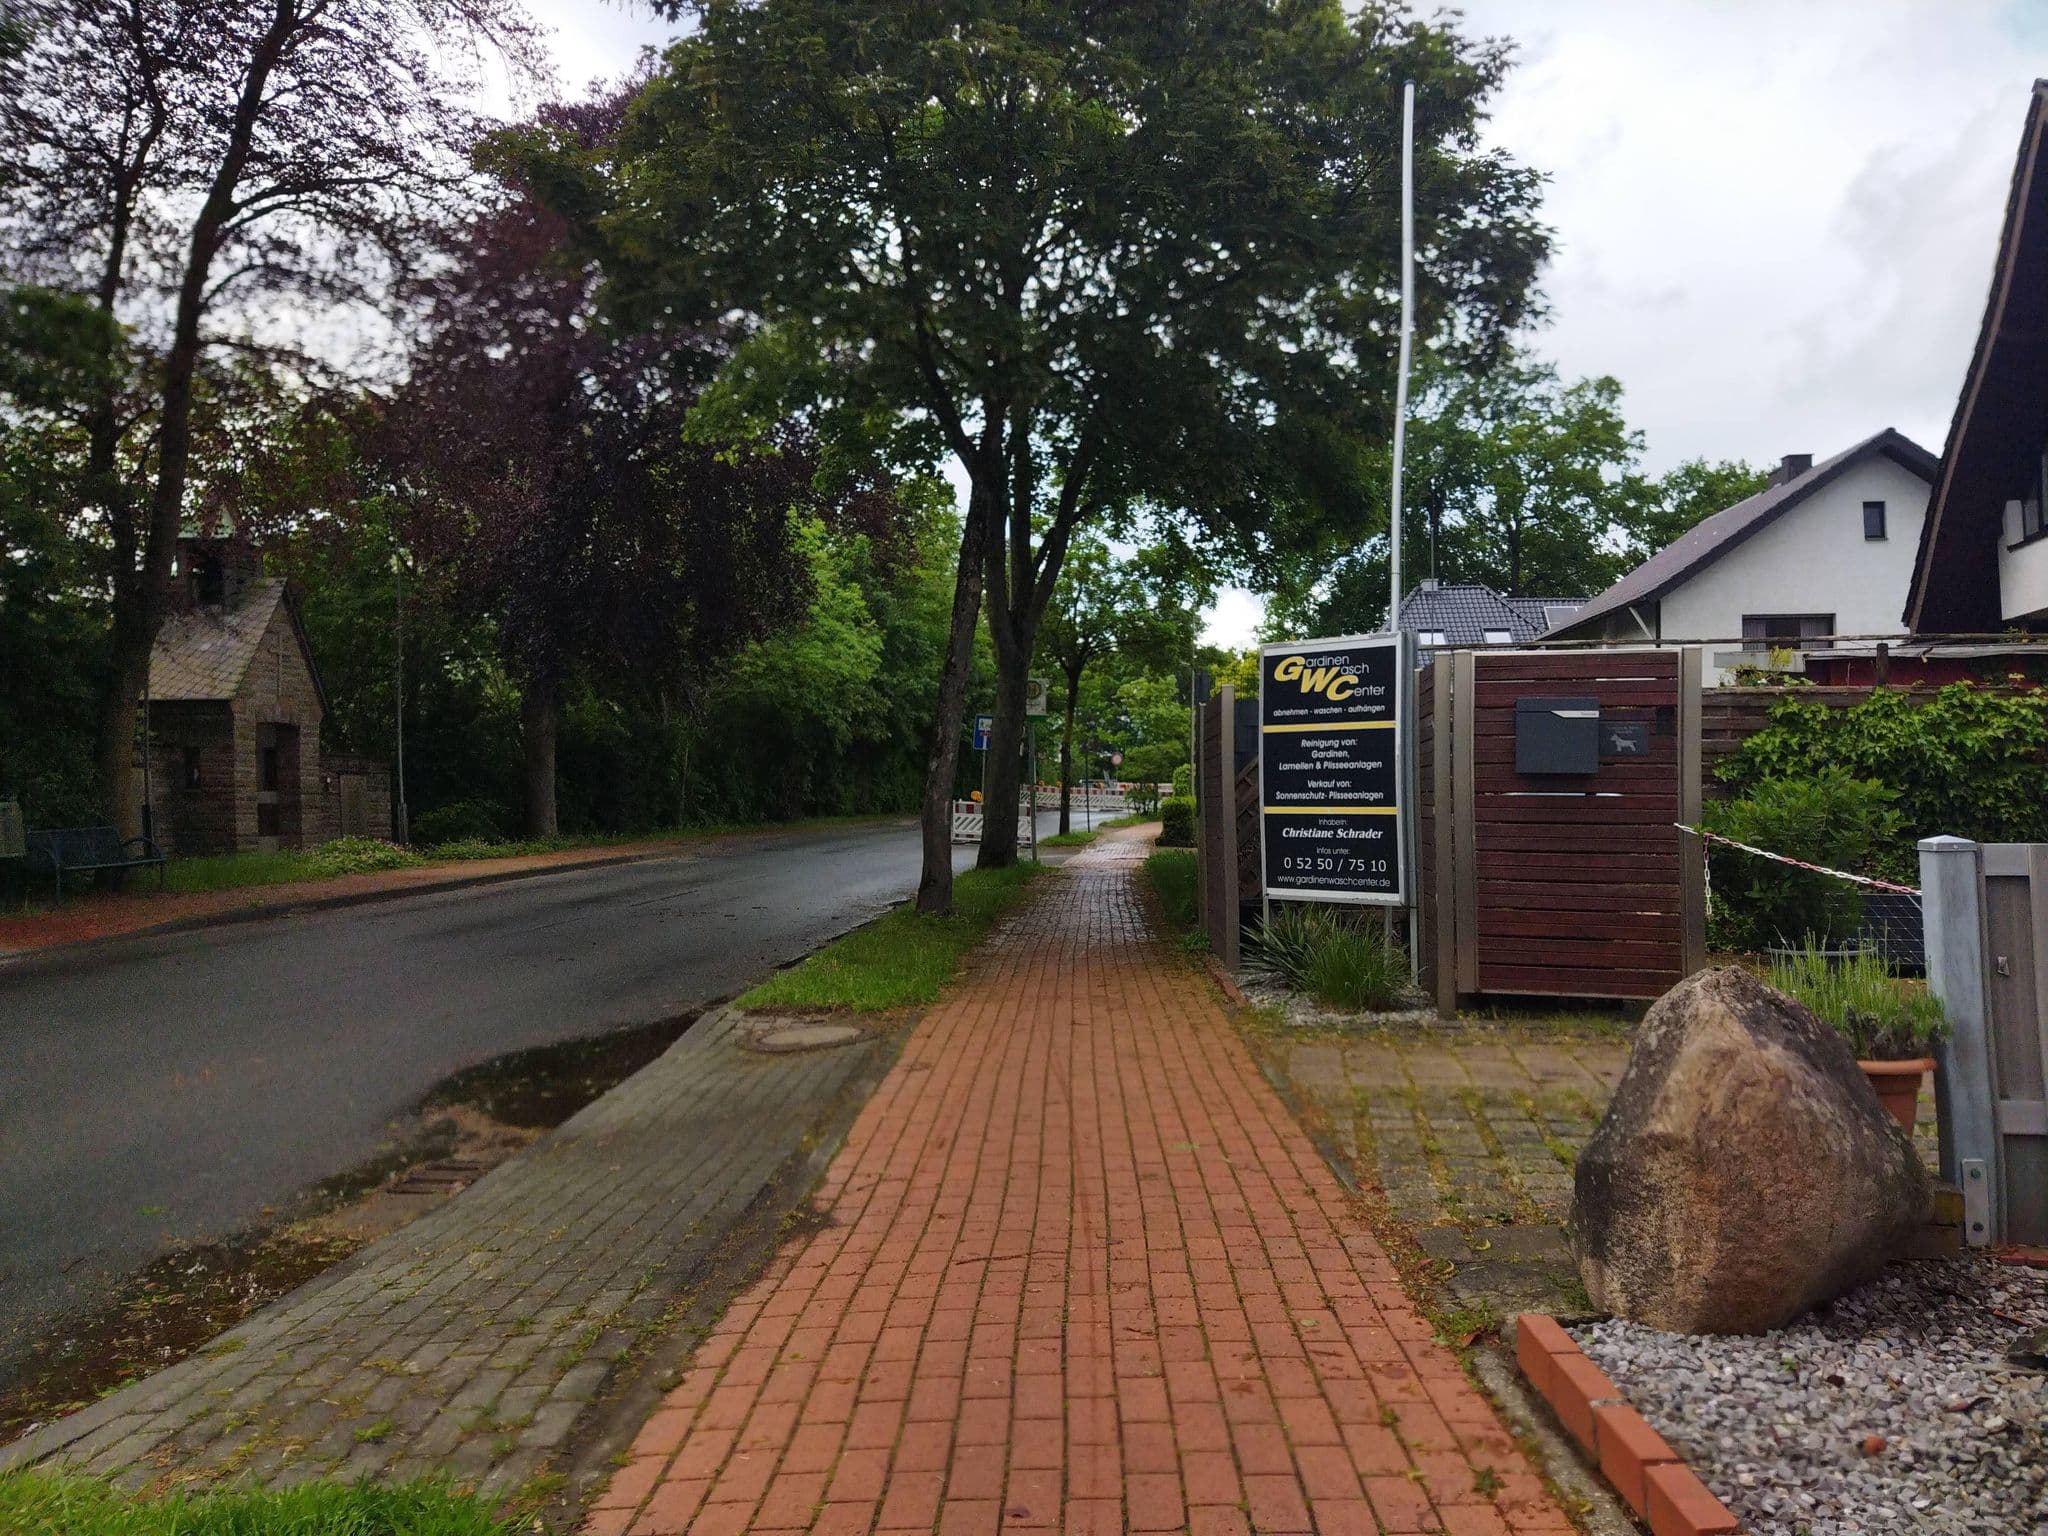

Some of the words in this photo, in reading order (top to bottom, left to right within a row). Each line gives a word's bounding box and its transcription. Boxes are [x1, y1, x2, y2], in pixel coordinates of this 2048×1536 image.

[1273, 707, 1308, 716] abnehmen
[1314, 706, 1342, 714] waschen
[1348, 704, 1385, 713] aufhängen
[1301, 739, 1339, 748] Reinigung
[1312, 750, 1350, 758] Gardinen,
[1279, 762, 1314, 770] Lamellen
[1316, 761, 1322, 769] &
[1323, 760, 1382, 770] Plisseeanlagen
[1307, 779, 1335, 788] Verkauf
[1329, 791, 1383, 801] Plisseeanlagen
[1282, 827, 1334, 838] Christiane
[1336, 828, 1383, 839] Schrader
[1283, 857, 1291, 869] 0
[1296, 857, 1312, 869] 52
[1317, 858, 1333, 870] 50
[1337, 858, 1343, 872] /
[1349, 859, 1365, 871] 75
[1371, 859, 1386, 872] 10
[1277, 875, 1390, 887] www.gardinenwaschcenter.de
